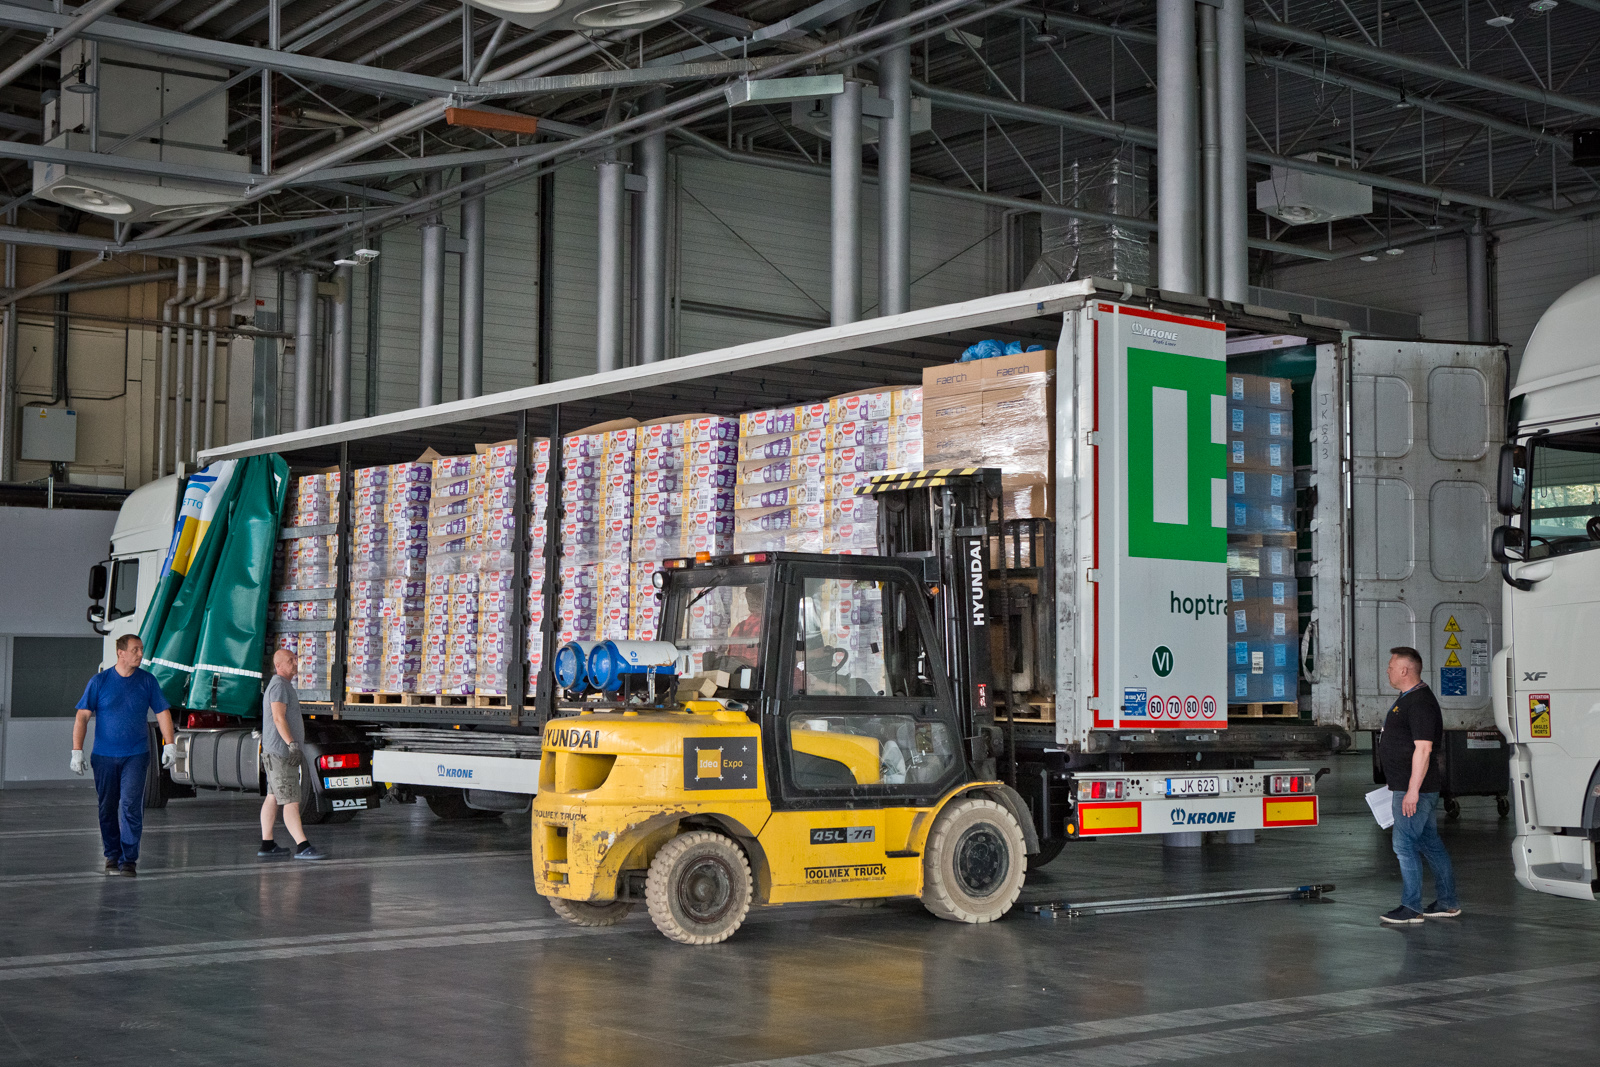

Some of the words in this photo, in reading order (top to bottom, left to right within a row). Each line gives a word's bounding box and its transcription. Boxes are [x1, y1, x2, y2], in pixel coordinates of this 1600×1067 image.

[1143, 326, 1178, 341] KRONE
[996, 365, 1030, 377] Faerch
[936, 373, 967, 385] Faerch
[969, 540, 985, 626] HYUNDAI
[1154, 651, 1170, 671] VI
[1522, 671, 1548, 681] XF
[1135, 692, 1146, 703] XL
[1150, 701, 1162, 714] 60
[1168, 701, 1180, 714] 70
[1186, 701, 1197, 713] 80
[1203, 701, 1214, 713] 90
[543, 729, 600, 749] HYUNDAI
[699, 759, 718, 768] Idea
[723, 759, 743, 769] Expo
[445, 768, 473, 779] KRONE
[330, 778, 349, 787] LOE
[354, 776, 371, 786] 814
[1180, 780, 1194, 793] JK
[1197, 779, 1215, 792] 623
[332, 798, 367, 807] DAF
[560, 812, 588, 821] TRUCK
[1186, 811, 1236, 825] KRONE
[804, 866, 850, 879] TOOLMEX
[853, 864, 887, 877] TRUCK
